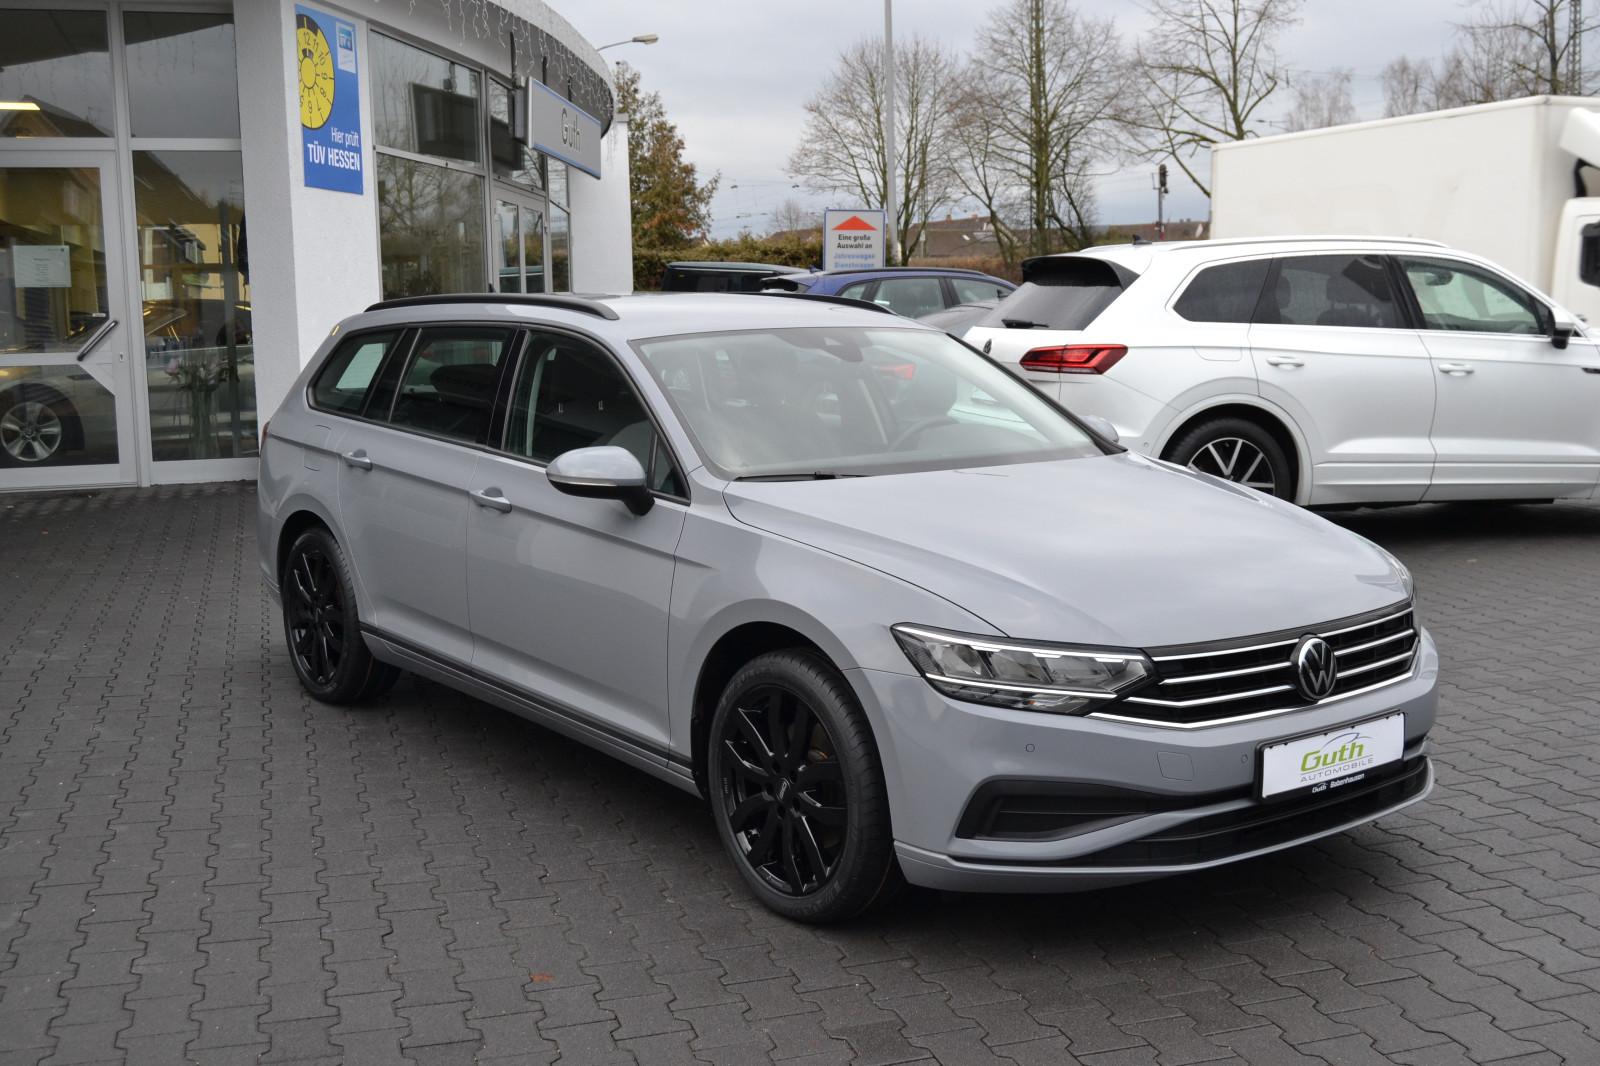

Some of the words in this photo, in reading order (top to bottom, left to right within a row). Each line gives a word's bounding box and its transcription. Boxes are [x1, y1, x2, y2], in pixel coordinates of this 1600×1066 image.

[303, 31, 311, 46] 12
[331, 127, 344, 144] Hier
[345, 130, 360, 148] prüft
[561, 107, 581, 152] Guth
[307, 140, 326, 165] TÜV
[327, 147, 360, 171] HESSEN
[838, 233, 852, 241] Eine
[1300, 742, 1365, 773] Guth
[1299, 757, 1374, 783] AUTOMOBILE
[1312, 785, 1327, 793] Guth
